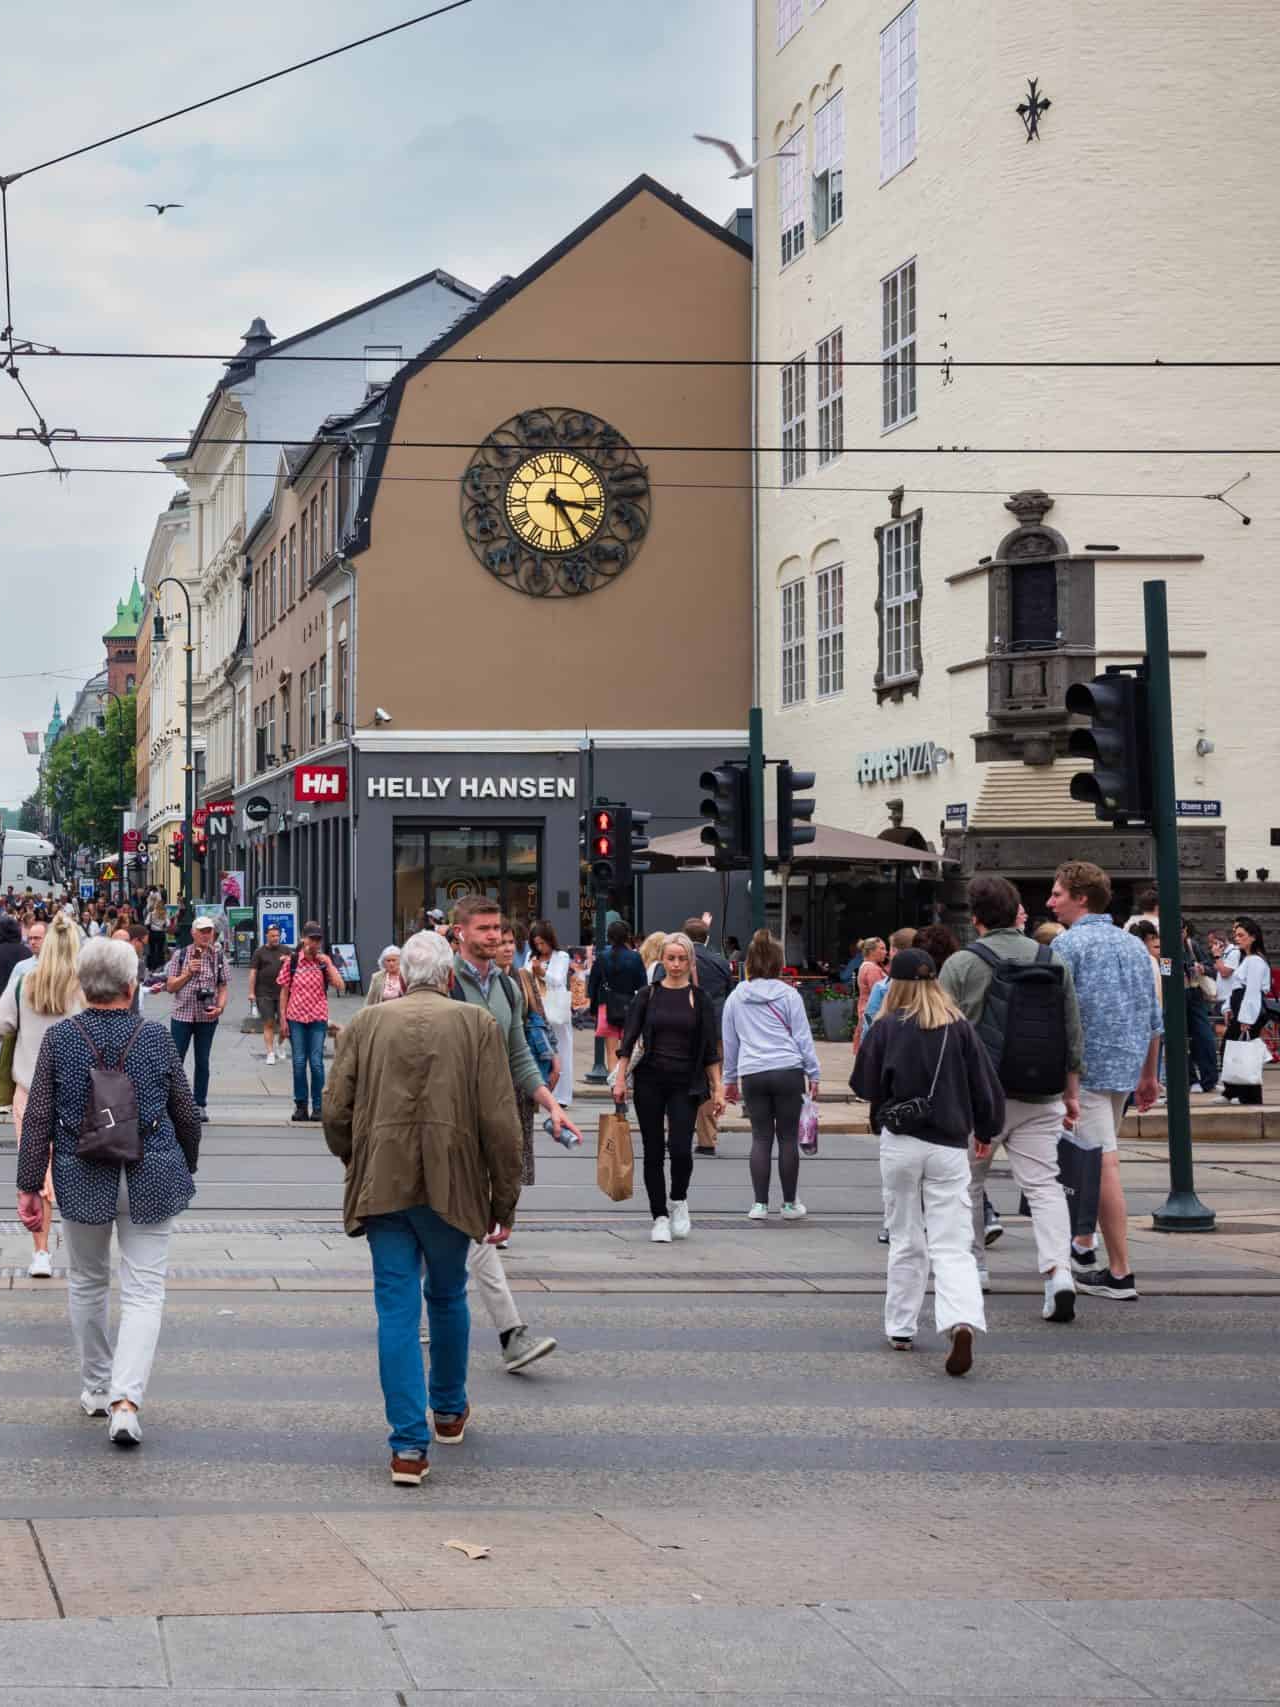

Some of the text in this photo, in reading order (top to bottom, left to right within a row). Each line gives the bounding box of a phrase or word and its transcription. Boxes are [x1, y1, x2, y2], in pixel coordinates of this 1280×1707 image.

[898, 741, 934, 777] PIZZA
[367, 777, 575, 798] HELLY HANSEN
[210, 816, 228, 835] N
[265, 899, 291, 909] Sone
